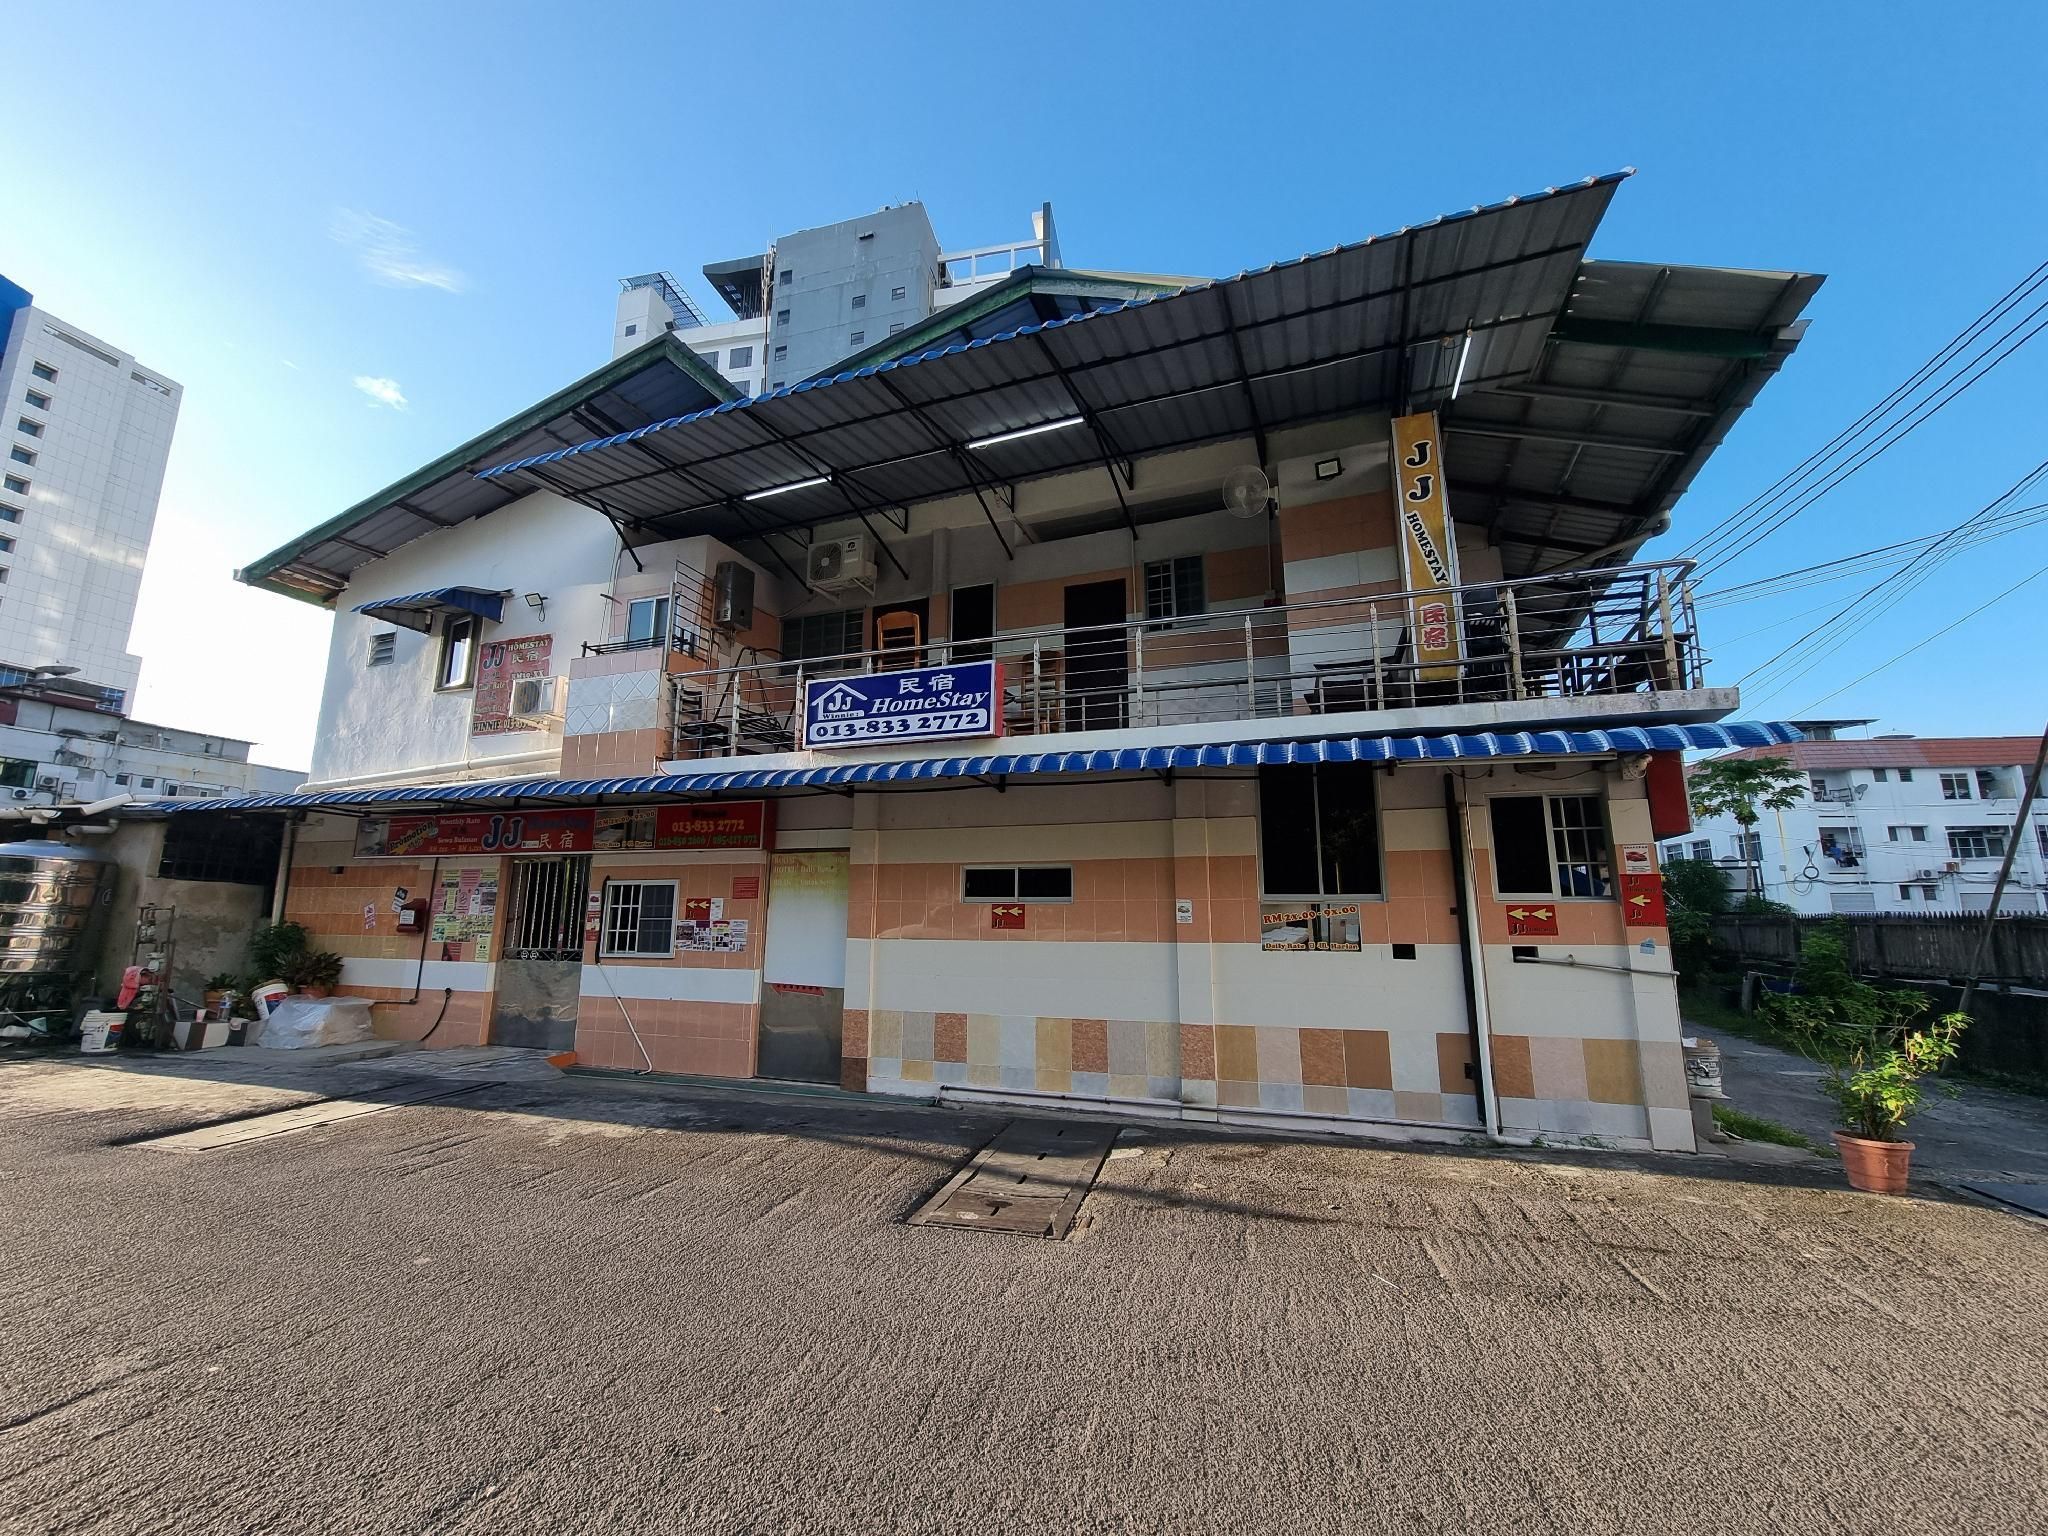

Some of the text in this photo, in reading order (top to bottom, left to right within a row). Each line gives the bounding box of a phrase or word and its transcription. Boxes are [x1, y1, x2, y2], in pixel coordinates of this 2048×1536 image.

[1406, 511, 1449, 584] HOMESTAY
[483, 639, 550, 669] JJ HOMESTAY
[900, 674, 955, 695] 民宿
[869, 691, 990, 714] HomeStay
[473, 719, 501, 731] WINNIE
[816, 712, 980, 737] 013-833 2772
[482, 814, 524, 850] JJ
[672, 818, 745, 833] 013-833 2772
[539, 830, 576, 849] 民宿
[1264, 914, 1283, 924] RM
